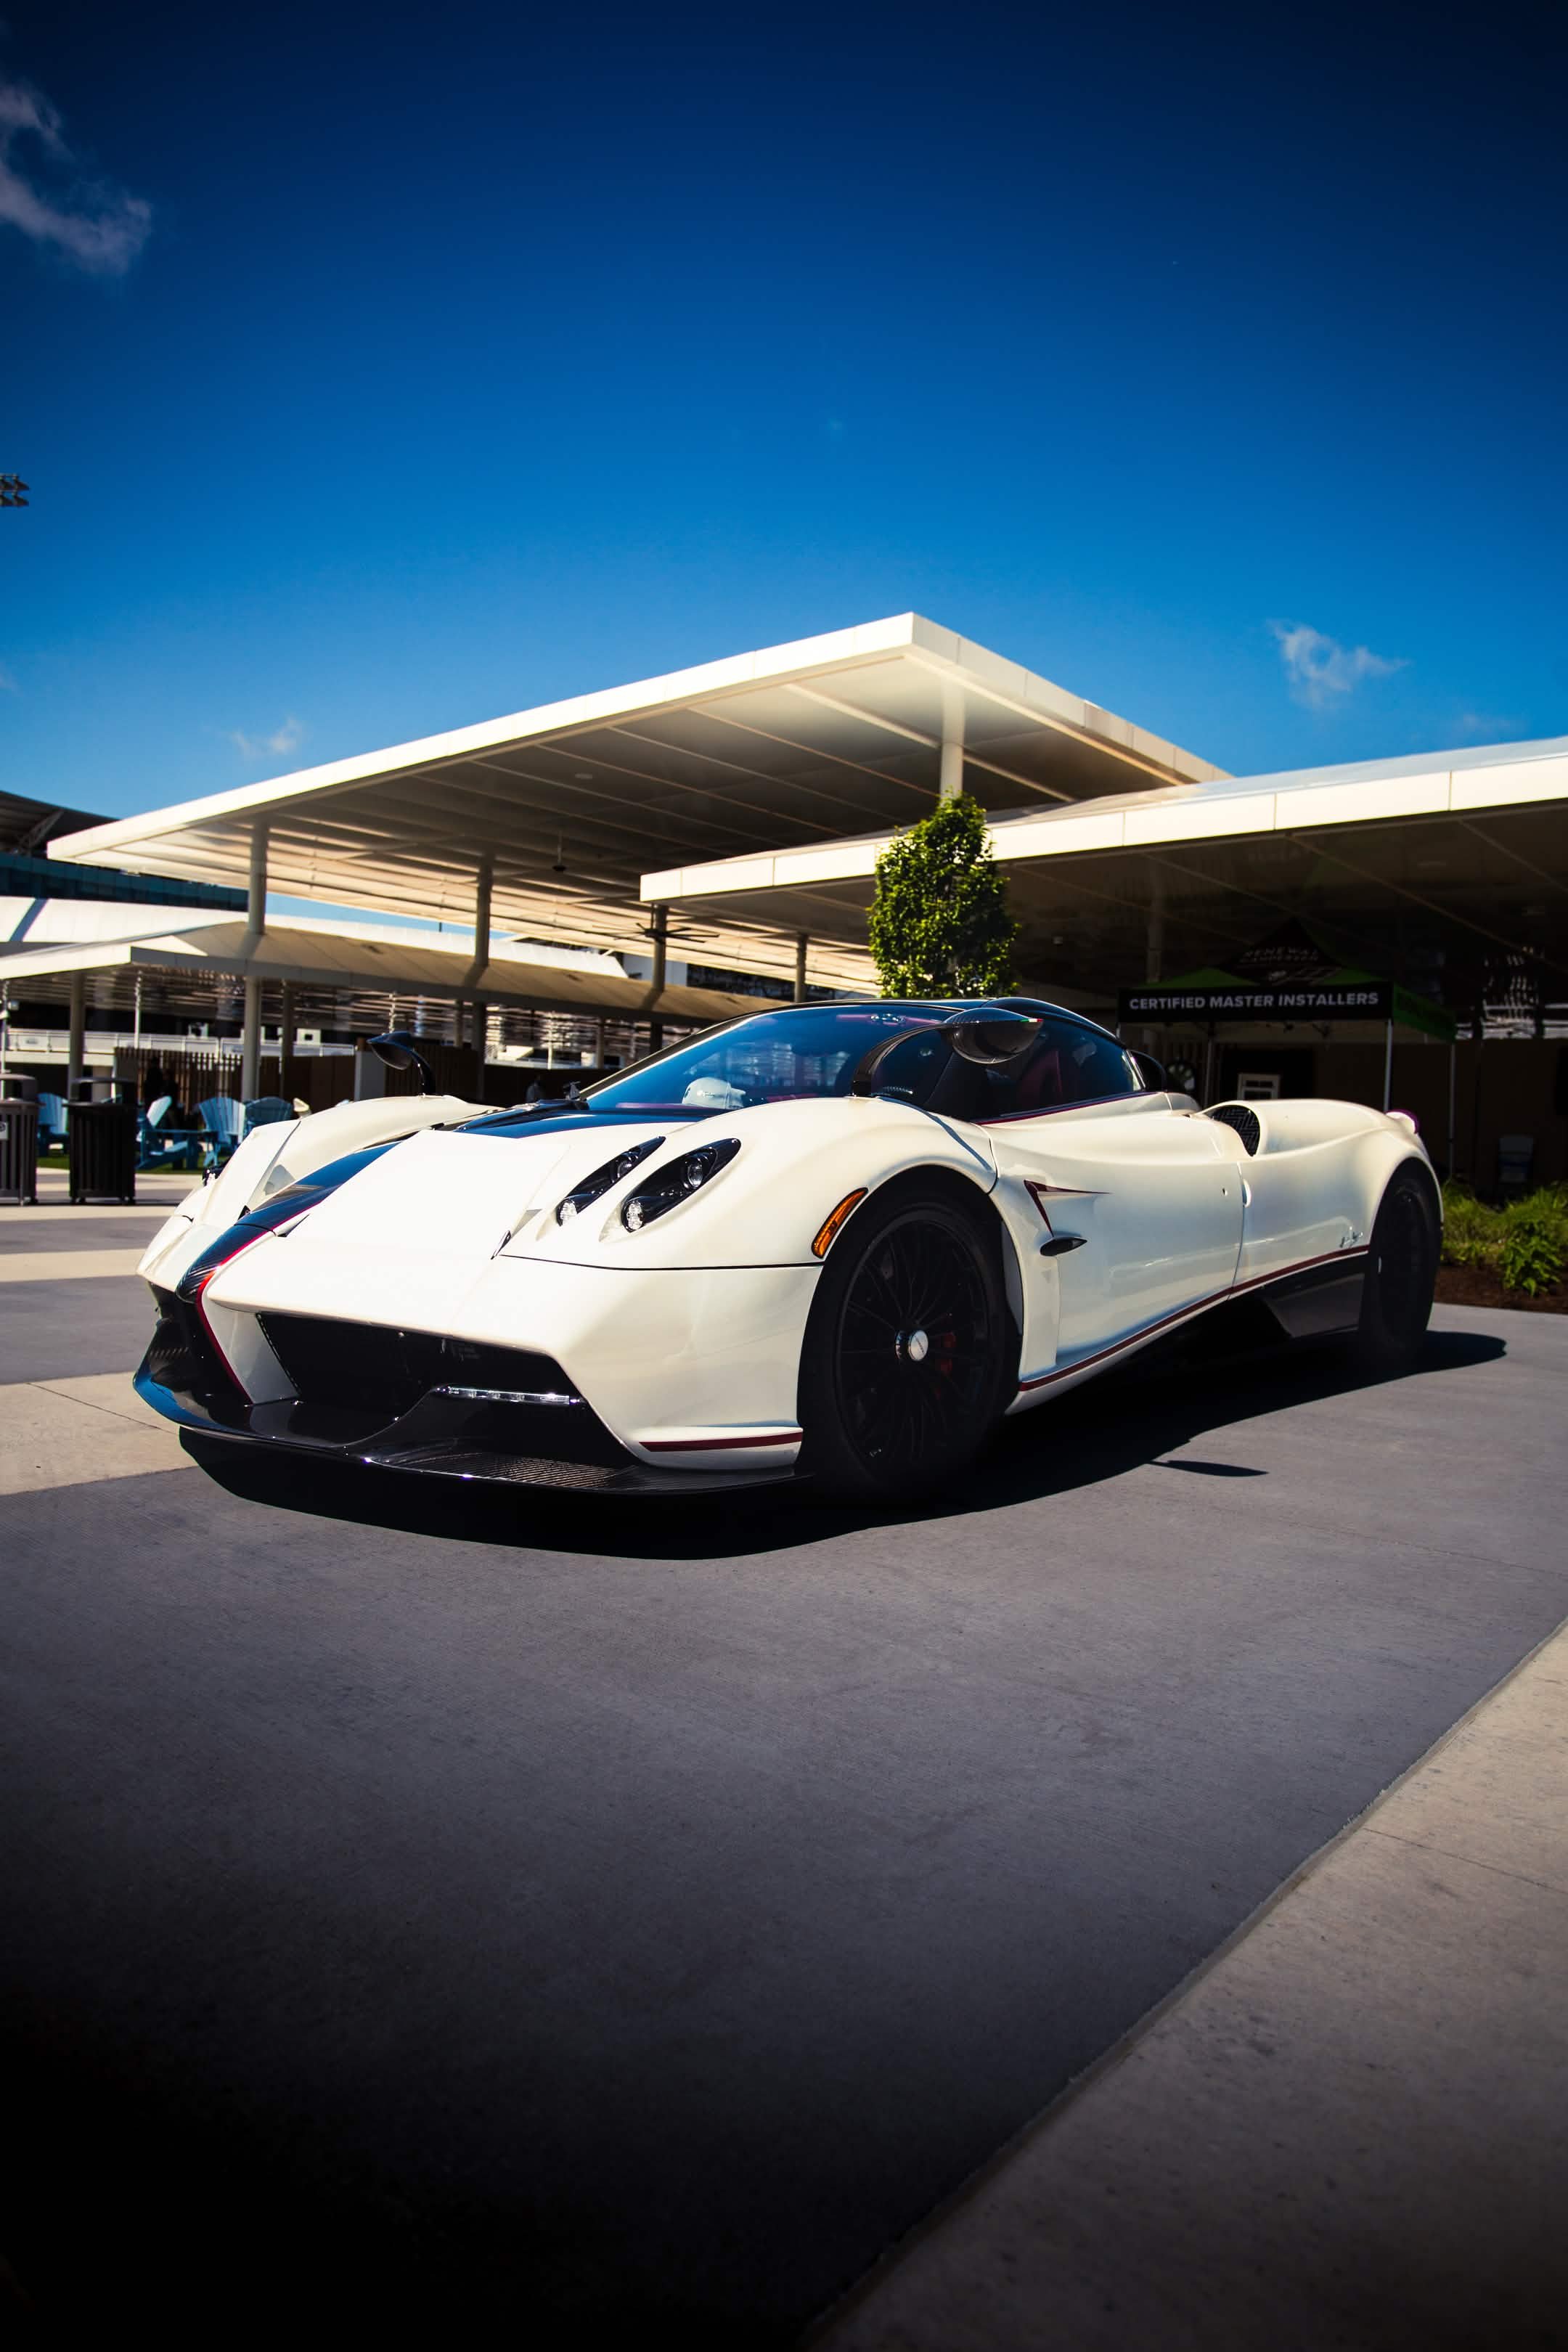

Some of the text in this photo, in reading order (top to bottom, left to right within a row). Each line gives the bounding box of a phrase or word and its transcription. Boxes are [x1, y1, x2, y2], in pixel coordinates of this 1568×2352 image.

[1130, 992, 1379, 1010] CERTIFIED MASTER INSTALLERS
